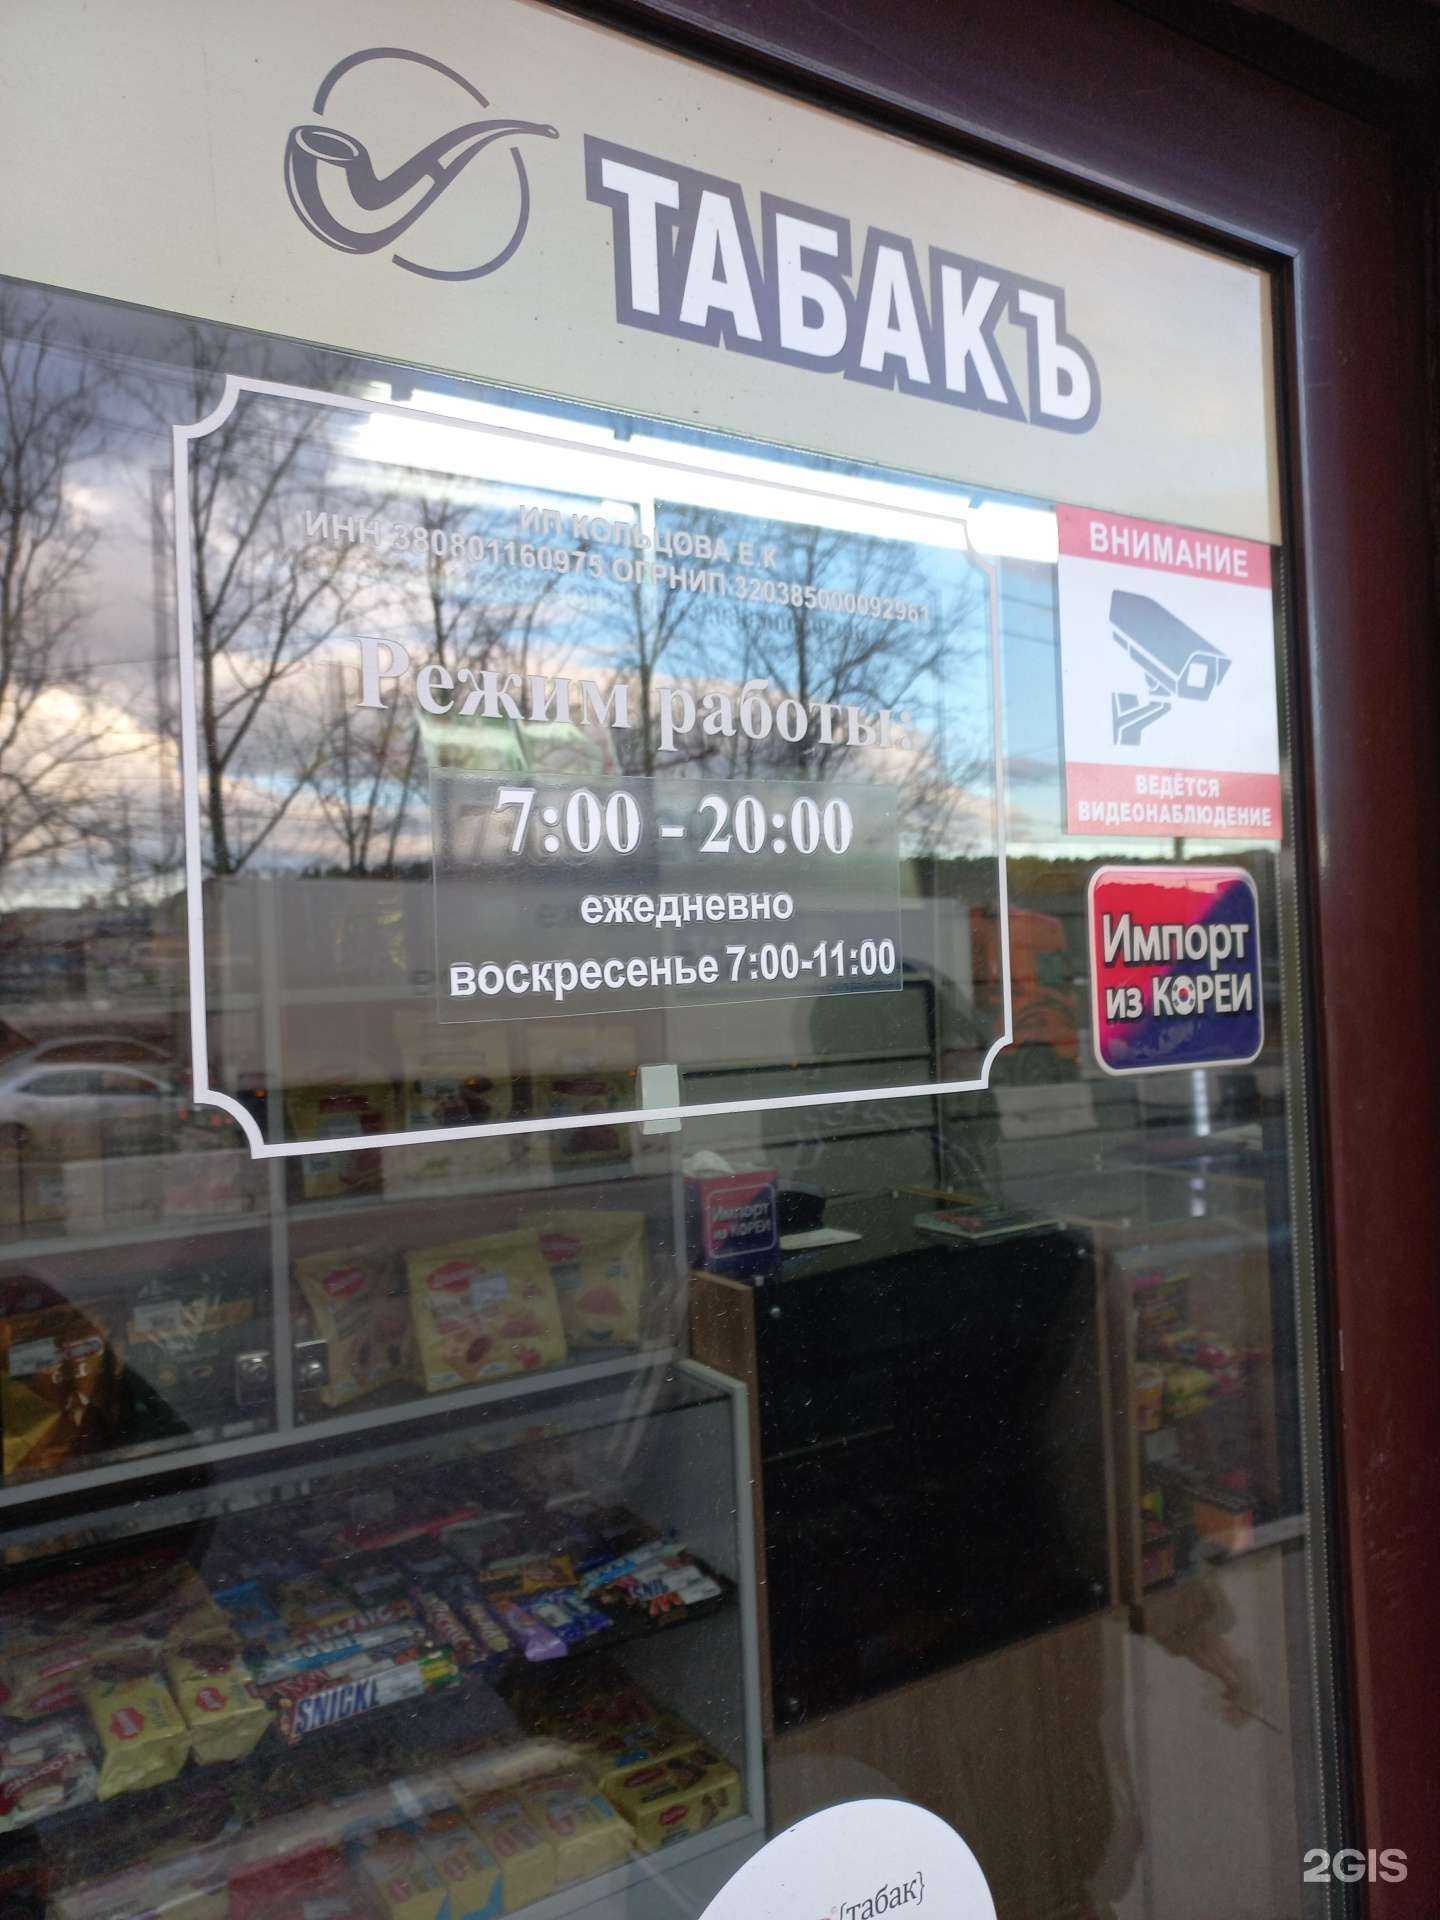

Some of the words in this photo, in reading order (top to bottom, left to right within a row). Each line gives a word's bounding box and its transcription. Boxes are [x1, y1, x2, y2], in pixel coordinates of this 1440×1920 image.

[598, 155, 1096, 424] ТАБАКЪ
[304, 509, 382, 545] ИНН
[392, 523, 604, 579] 380801160975
[611, 558, 727, 597] ОГРНИП
[519, 504, 562, 536] ИП
[571, 512, 732, 563] КОЛЬЦОВА
[1088, 521, 1250, 579] ВНИМАНИЕ
[352, 634, 633, 730] Режим
[656, 677, 912, 752] работы:
[1077, 799, 1273, 828] ВИДЕОНАБЛЮДЕНИЕ
[1135, 773, 1220, 799] ВЕДЁТСЯ
[497, 786, 642, 855] 7:00
[659, 823, 687, 840] -
[698, 793, 854, 856] 20:00
[580, 891, 795, 928] ежедневно
[449, 952, 720, 1001] воскресенье
[725, 938, 897, 982] 7:00-11:00
[1102, 913, 1250, 971] Импорт
[1105, 987, 1144, 1020] из
[1152, 972, 1254, 1018] КОРЕИ
